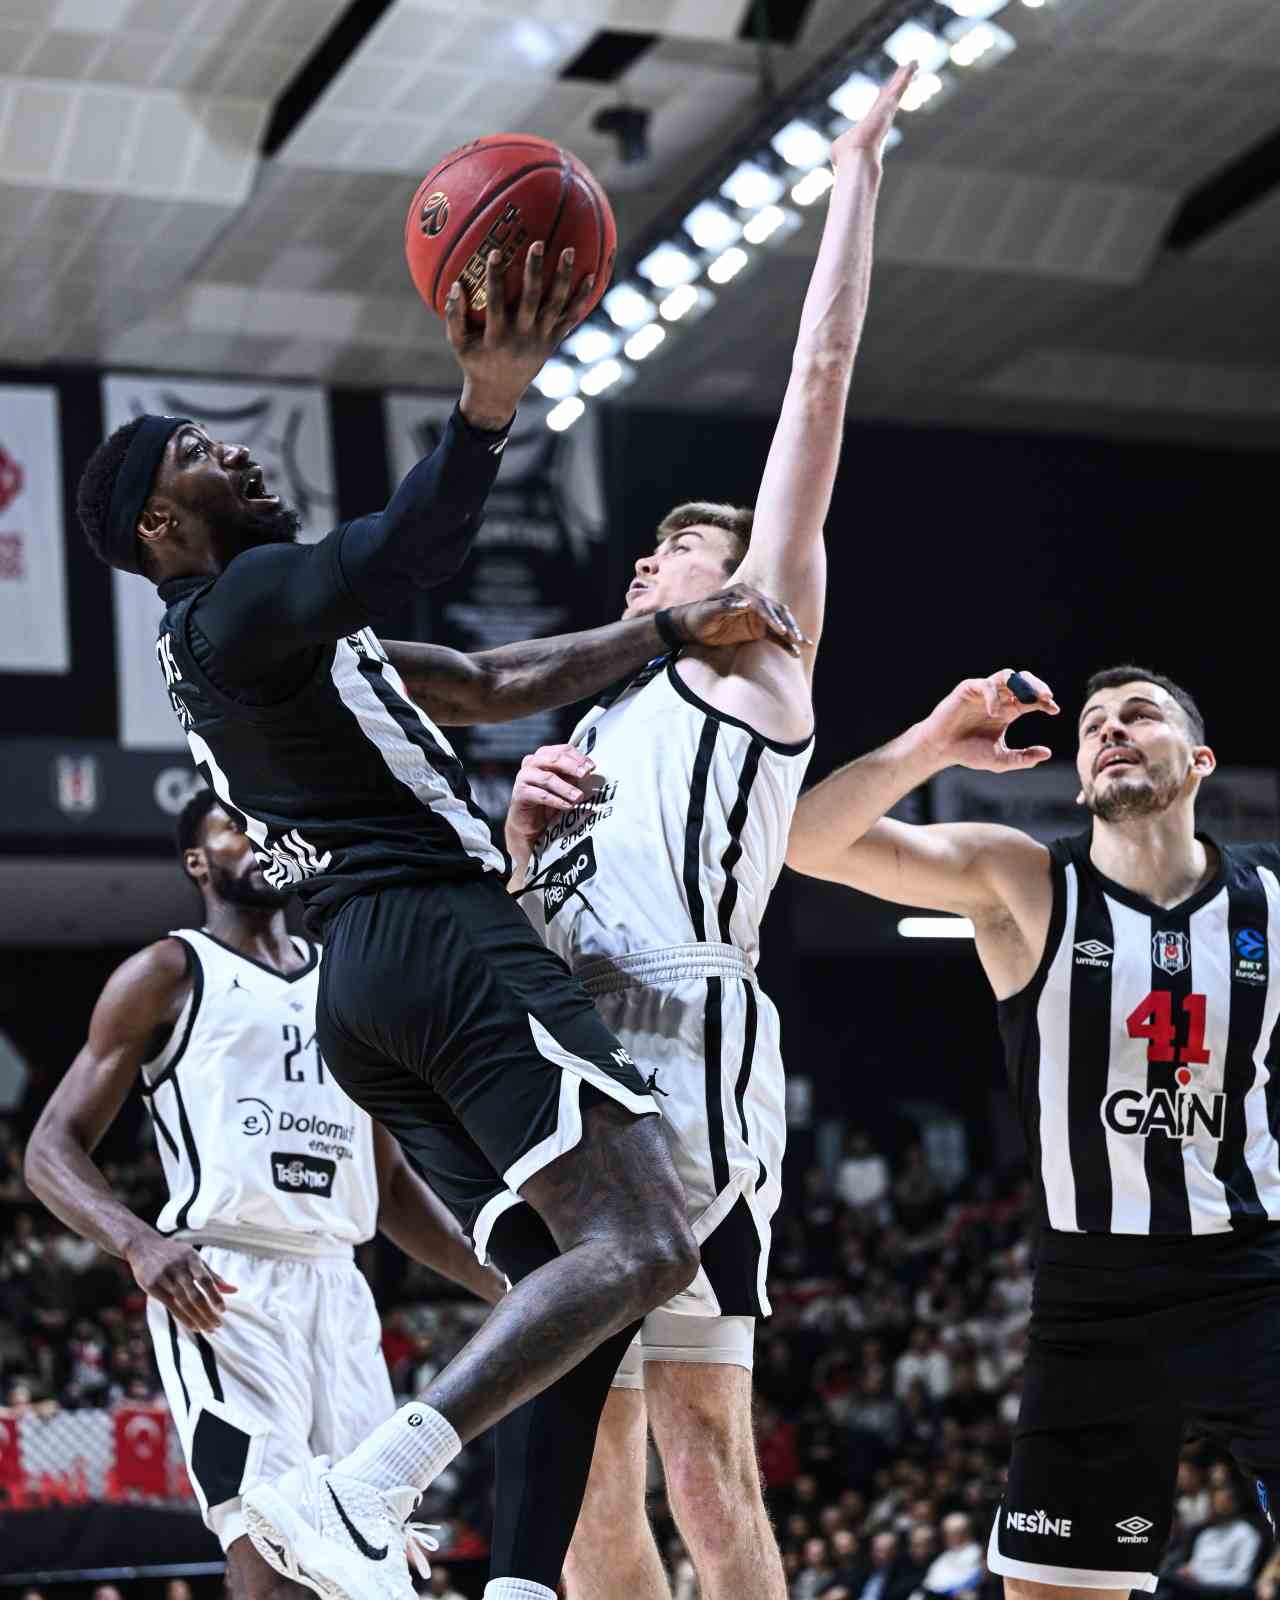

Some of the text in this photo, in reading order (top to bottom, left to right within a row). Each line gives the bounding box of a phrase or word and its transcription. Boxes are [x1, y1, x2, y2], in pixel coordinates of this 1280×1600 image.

[1075, 957, 1109, 968] umbro
[1126, 990, 1211, 1064] 41
[282, 1024, 324, 1085] 21
[1006, 1509, 1073, 1538] NESINE
[1117, 1536, 1149, 1544] umbro
